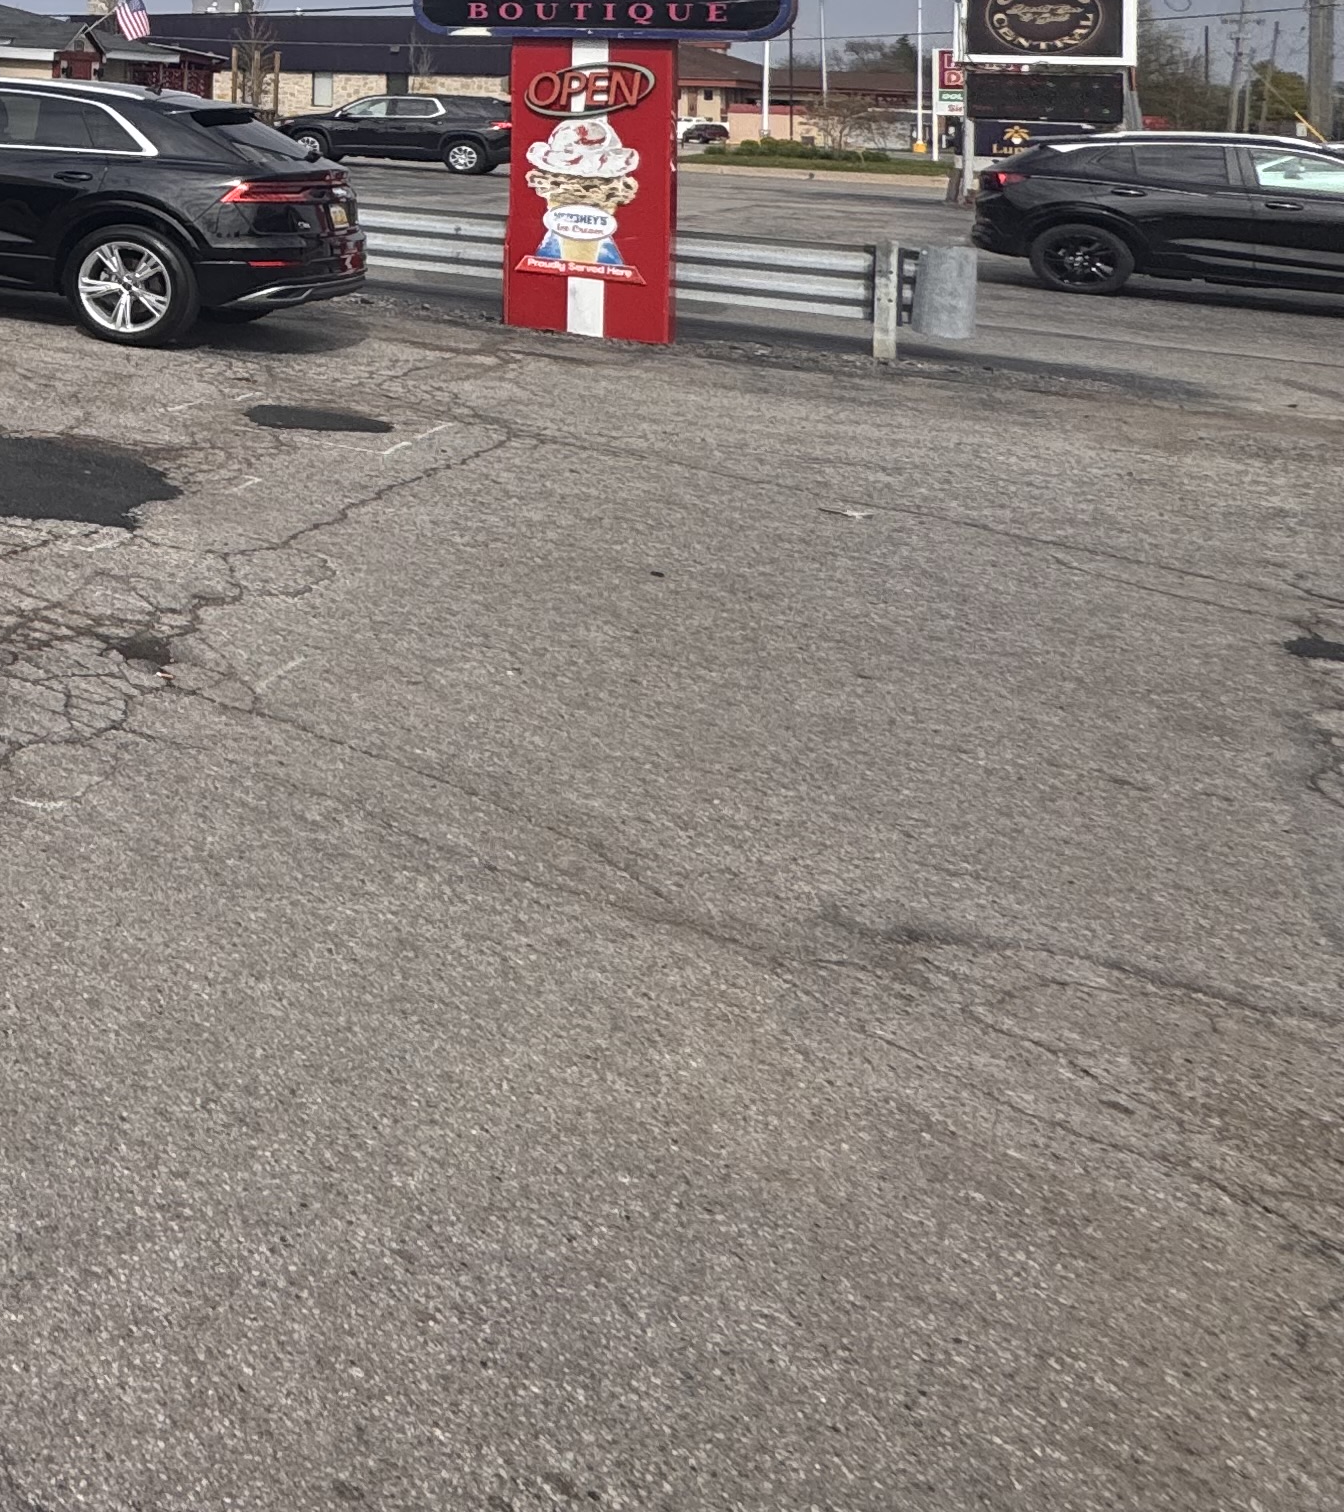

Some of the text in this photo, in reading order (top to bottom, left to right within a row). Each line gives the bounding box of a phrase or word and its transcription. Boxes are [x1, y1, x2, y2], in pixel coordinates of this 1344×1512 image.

[468, 2, 729, 25] BOUTIQUE
[993, 13, 1094, 50] CENTRAL
[527, 71, 641, 107] OPEN
[527, 258, 566, 272] Proudly
[568, 262, 604, 274] Served
